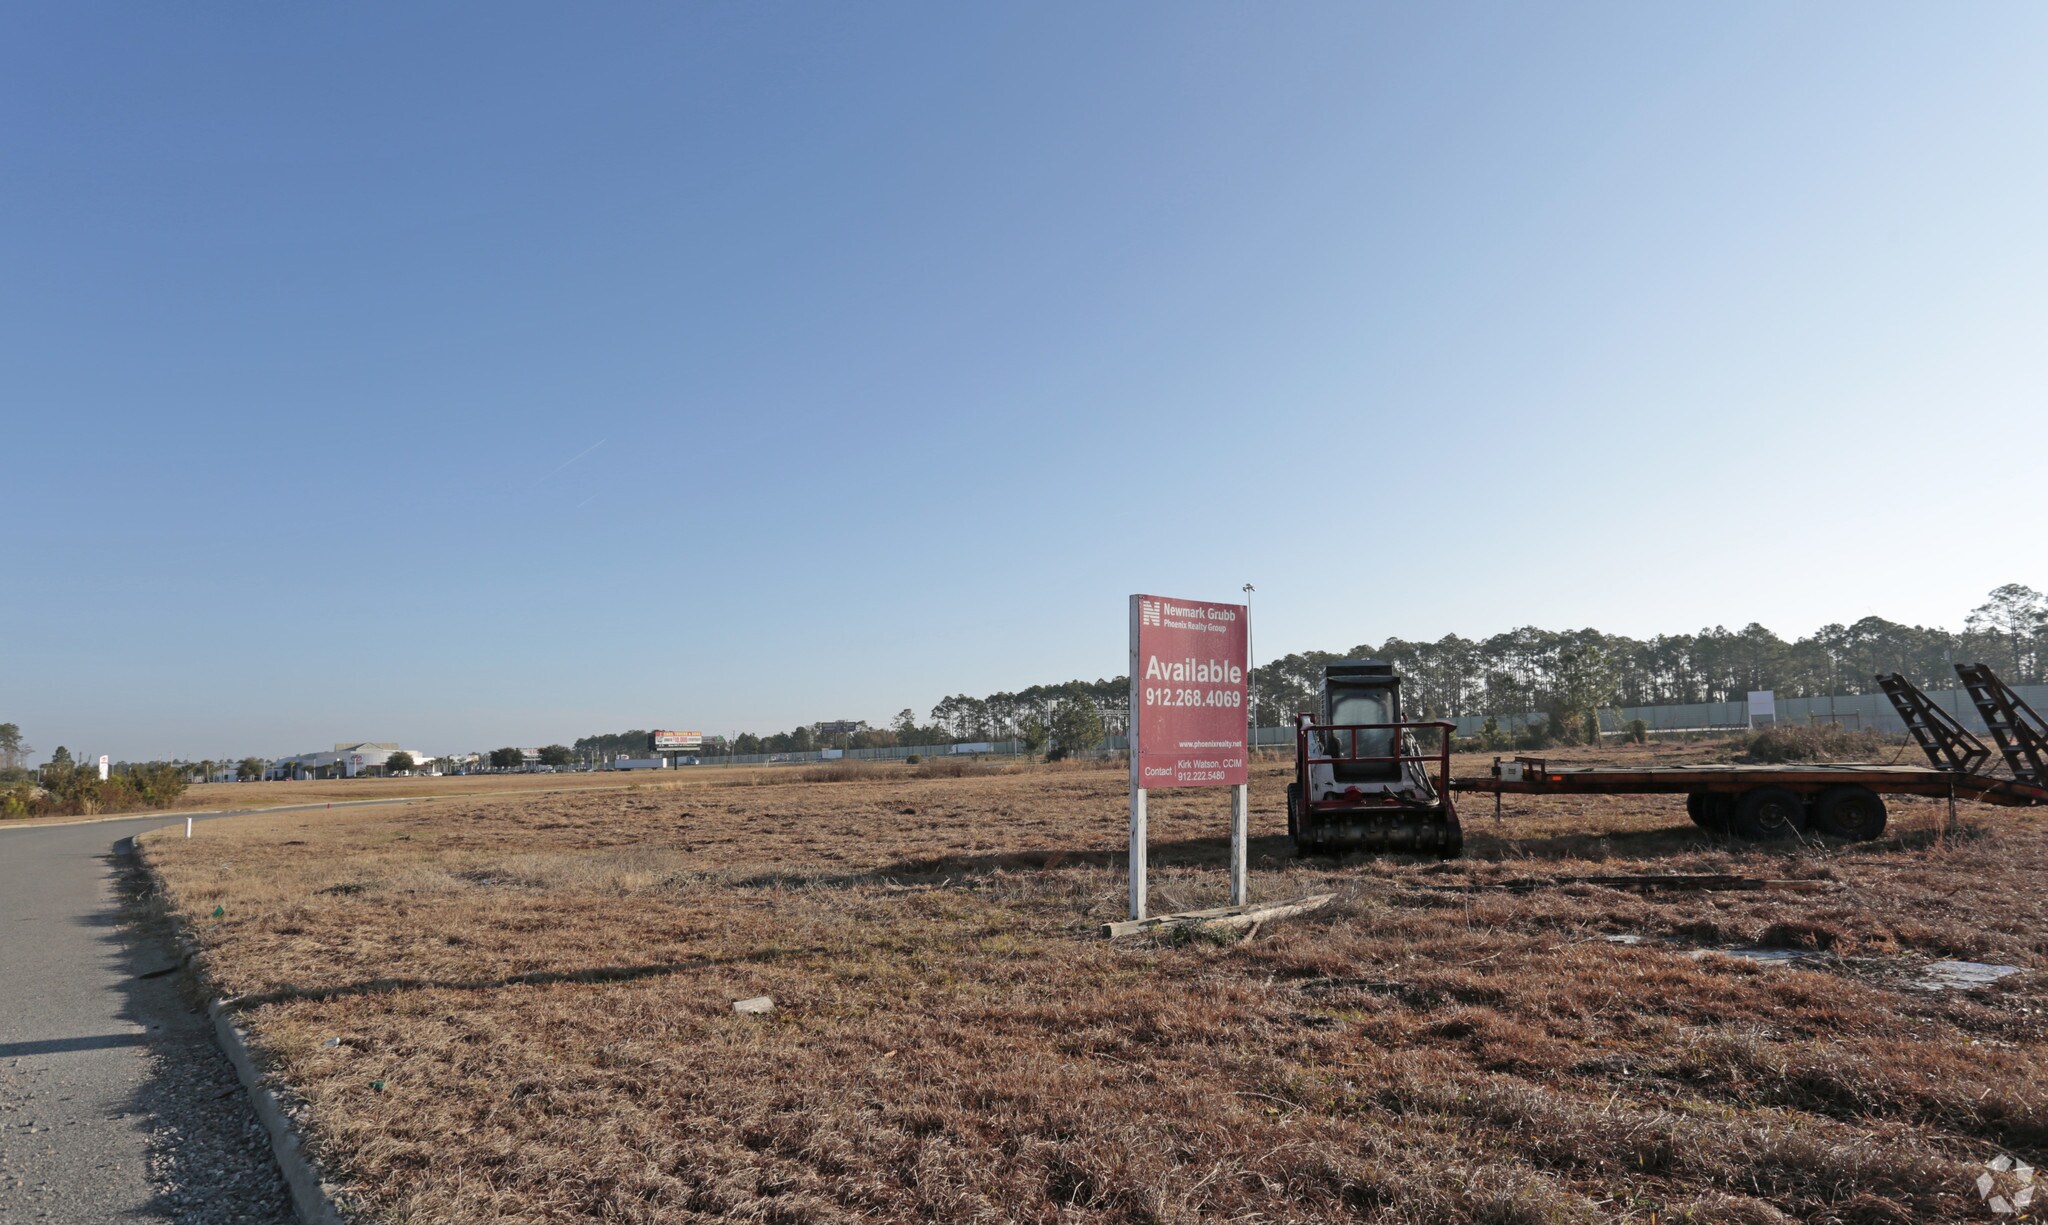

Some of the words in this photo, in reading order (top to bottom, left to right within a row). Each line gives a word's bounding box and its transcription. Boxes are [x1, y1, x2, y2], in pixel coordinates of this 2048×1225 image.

[1164, 602, 1205, 619] Newmark
[1207, 608, 1236, 621] Grubb
[1164, 619, 1187, 630] Phoenix
[1188, 622, 1207, 633] Realty
[1208, 623, 1227, 633] Group
[1145, 655, 1242, 684] Available
[1146, 687, 1241, 708] 912.268.4069
[1178, 740, 1242, 749] www.phoenixrealty.net
[1177, 759, 1192, 769] Kirk
[1223, 759, 1242, 768] CCIM
[1144, 766, 1172, 776] Contact
[1177, 770, 1225, 781] 912.222.5480
